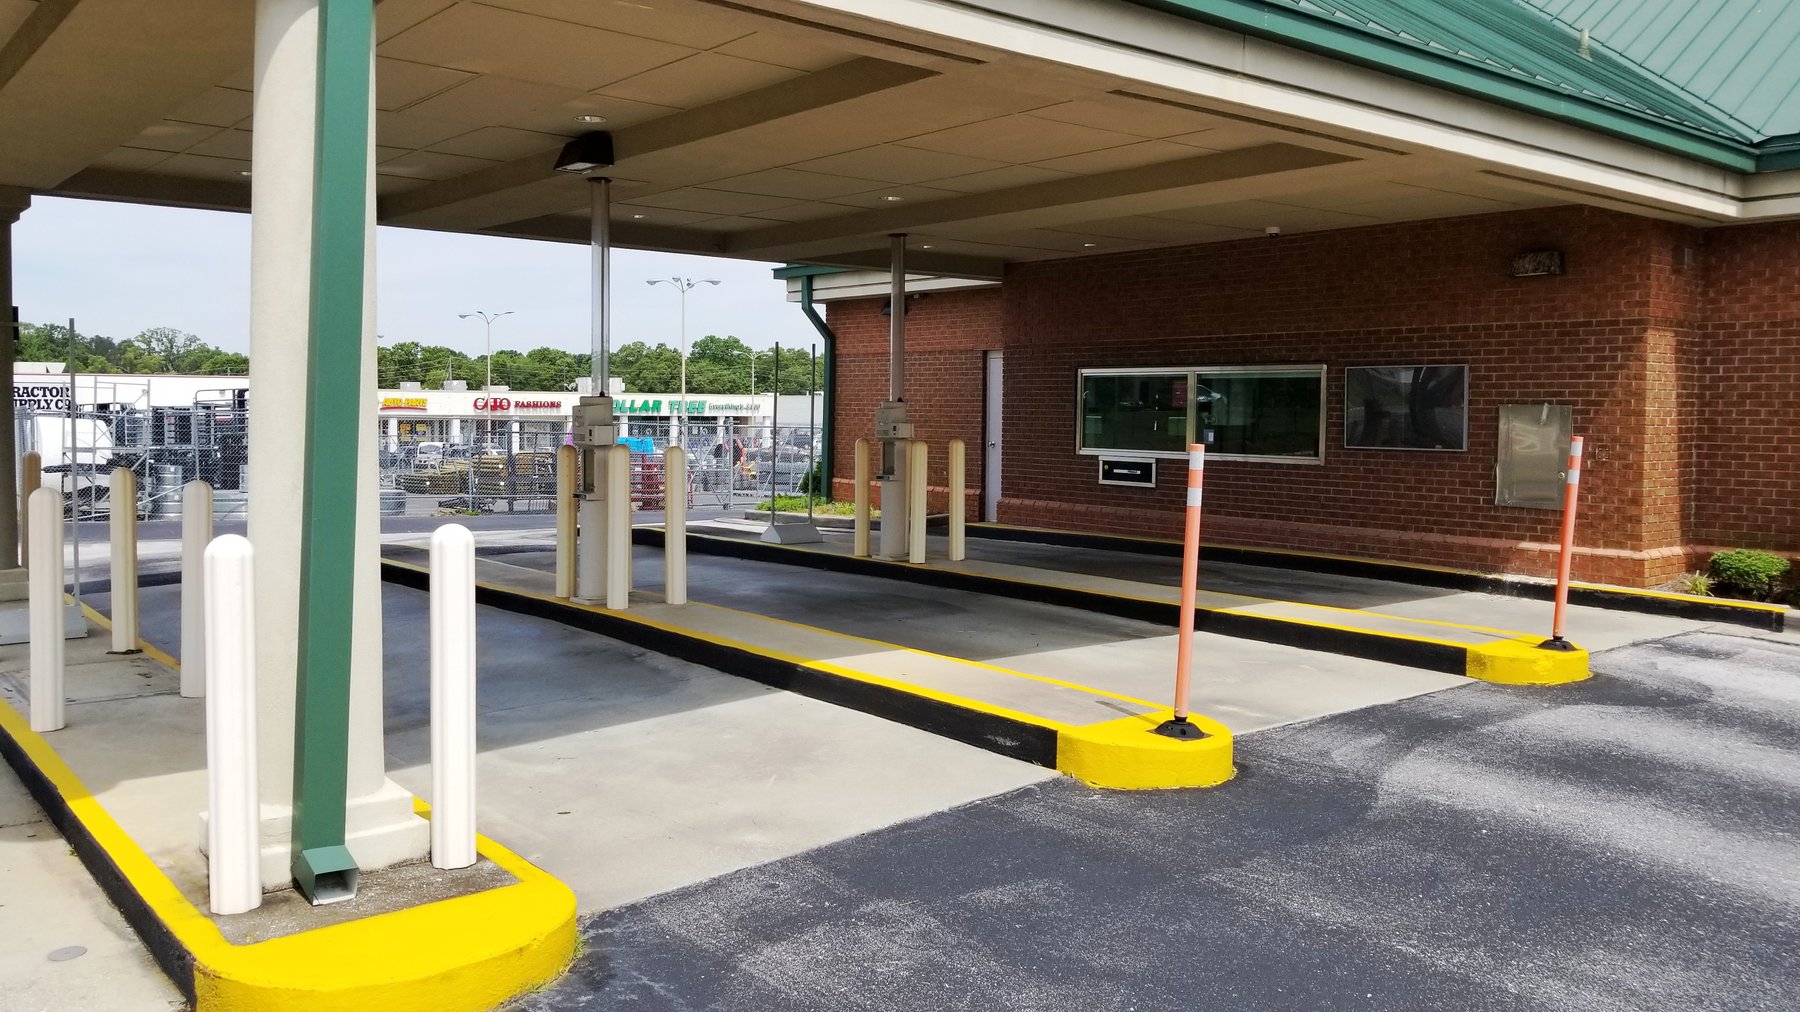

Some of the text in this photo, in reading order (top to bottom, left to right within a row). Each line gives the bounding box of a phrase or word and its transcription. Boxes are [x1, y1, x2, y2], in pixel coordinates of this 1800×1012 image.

[14, 387, 70, 398] RACTOR
[473, 397, 511, 411] CATO
[612, 399, 662, 413] OLLAR
[669, 400, 706, 414] TREE
